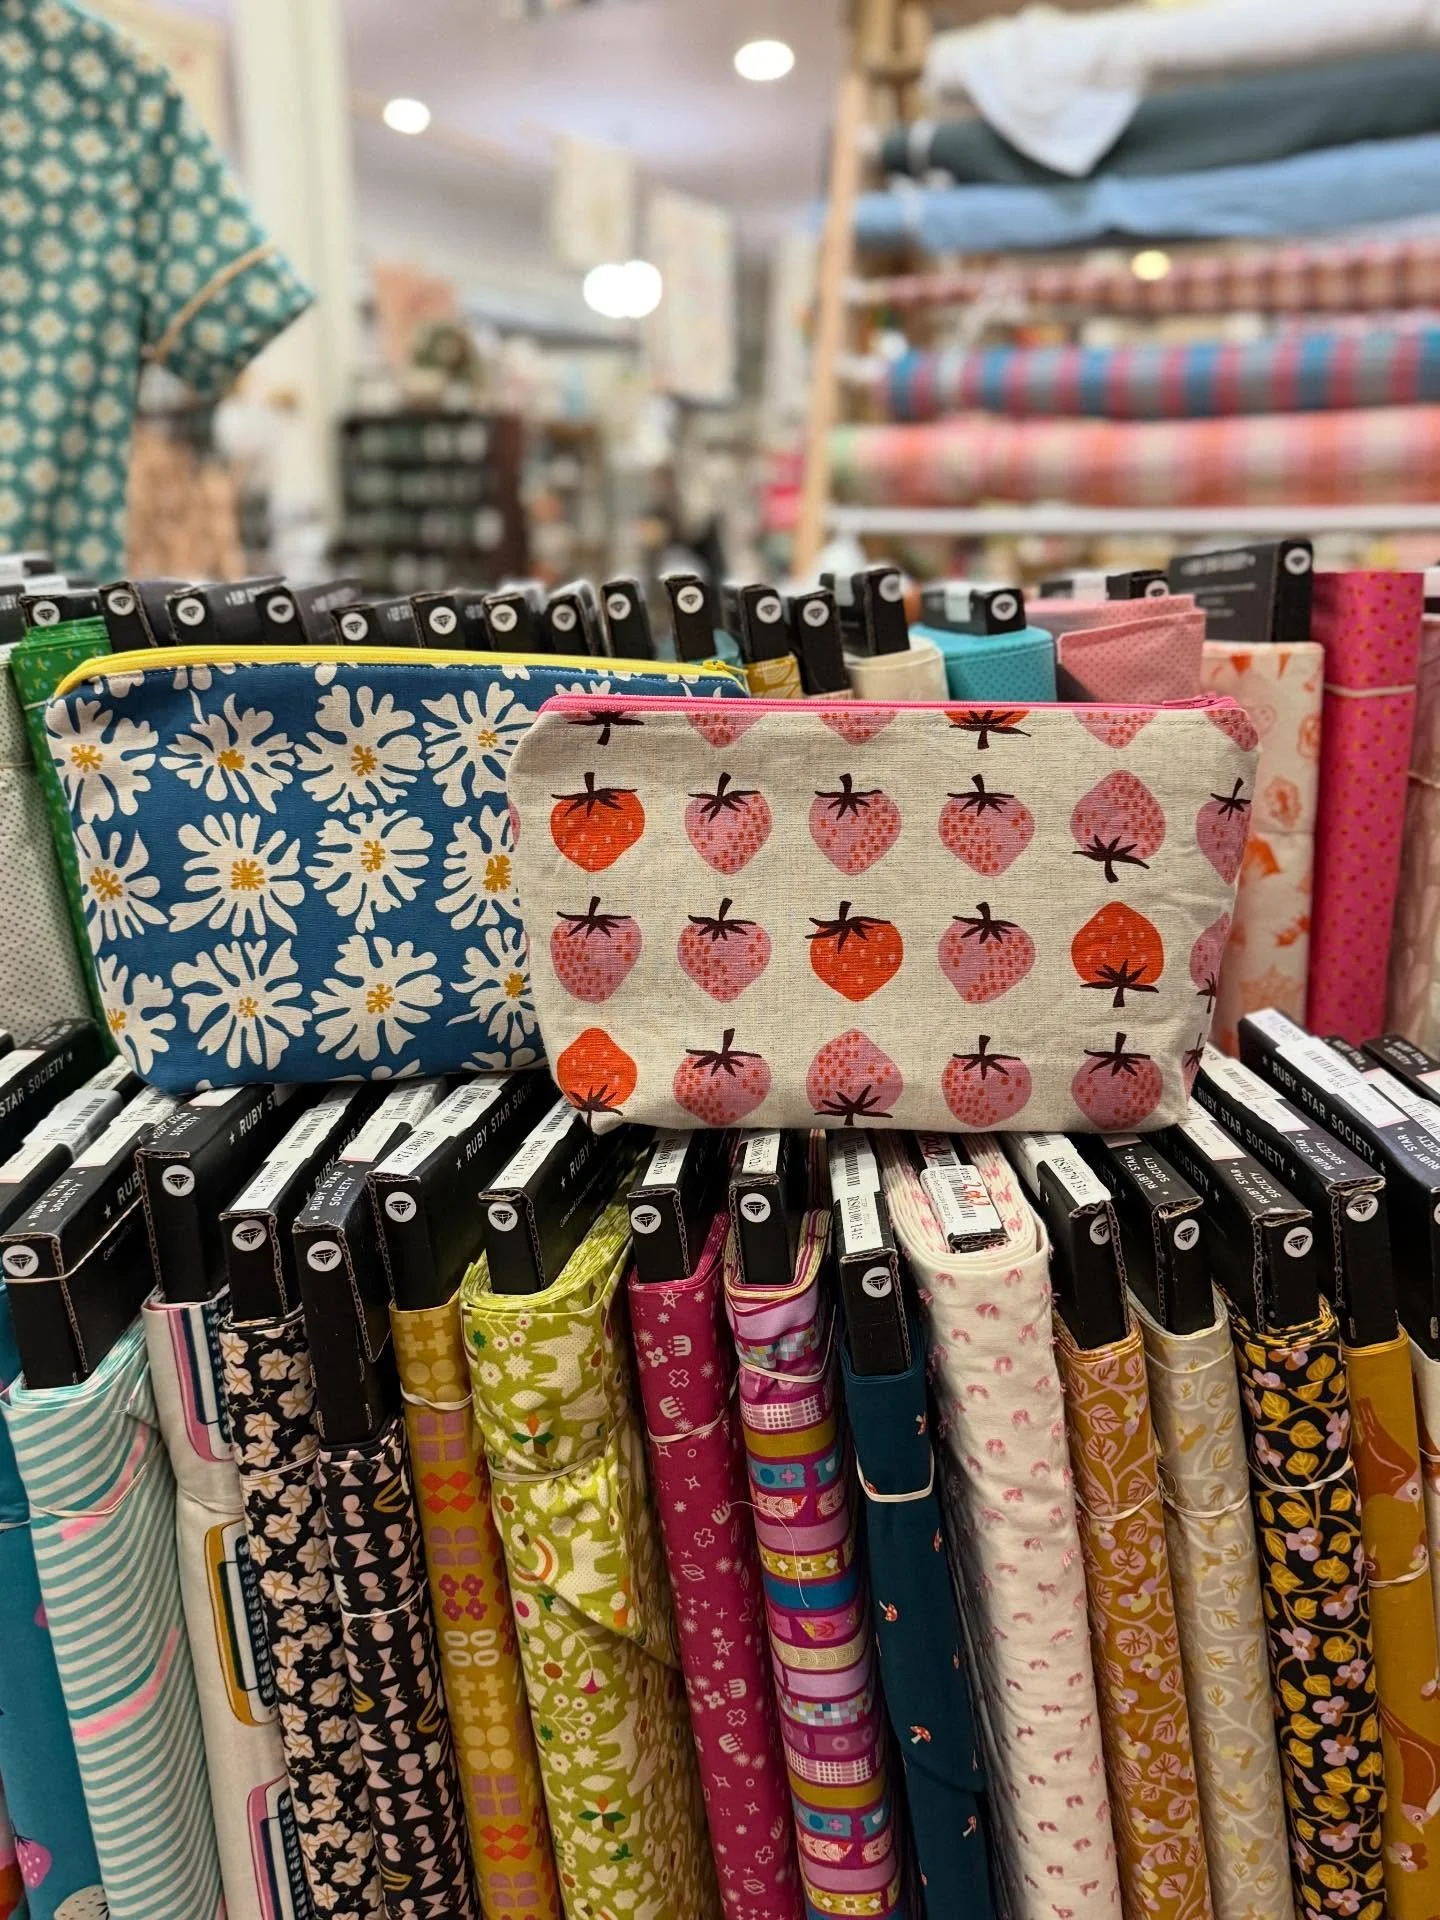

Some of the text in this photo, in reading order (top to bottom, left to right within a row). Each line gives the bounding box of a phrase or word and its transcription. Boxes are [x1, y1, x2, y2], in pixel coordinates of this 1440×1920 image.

[0, 1053, 65, 1118] STAR SOCIETY
[239, 1101, 263, 1137] RUBY
[1197, 1086, 1218, 1113] RUBY
[1220, 1106, 1242, 1136] STAR
[1246, 1130, 1286, 1171] SOCIETY
[1272, 1060, 1297, 1092] RUBY
[1301, 1087, 1326, 1120] STAR
[1331, 1113, 1375, 1162] SOCIETY
[465, 1129, 488, 1161] RUBY
[491, 1104, 511, 1133] STAR
[569, 1140, 590, 1179] RUBY
[1142, 1156, 1171, 1183] SOCIETY
[1295, 1139, 1337, 1171] RUBY STAR
[1313, 1141, 1347, 1166] SOCIETY
[1397, 1133, 1440, 1171] RUBY STAR
[1124, 1154, 1159, 1190] RUBY STAR
[1230, 1168, 1271, 1205] RUBY STAR
[1249, 1171, 1282, 1199] SOCIETY
[27, 1178, 74, 1220] RUBY STAR
[50, 1182, 84, 1213] SOCIETY
[309, 1171, 345, 1211] RUBY STAR
[329, 1177, 356, 1207] SOCIETY
